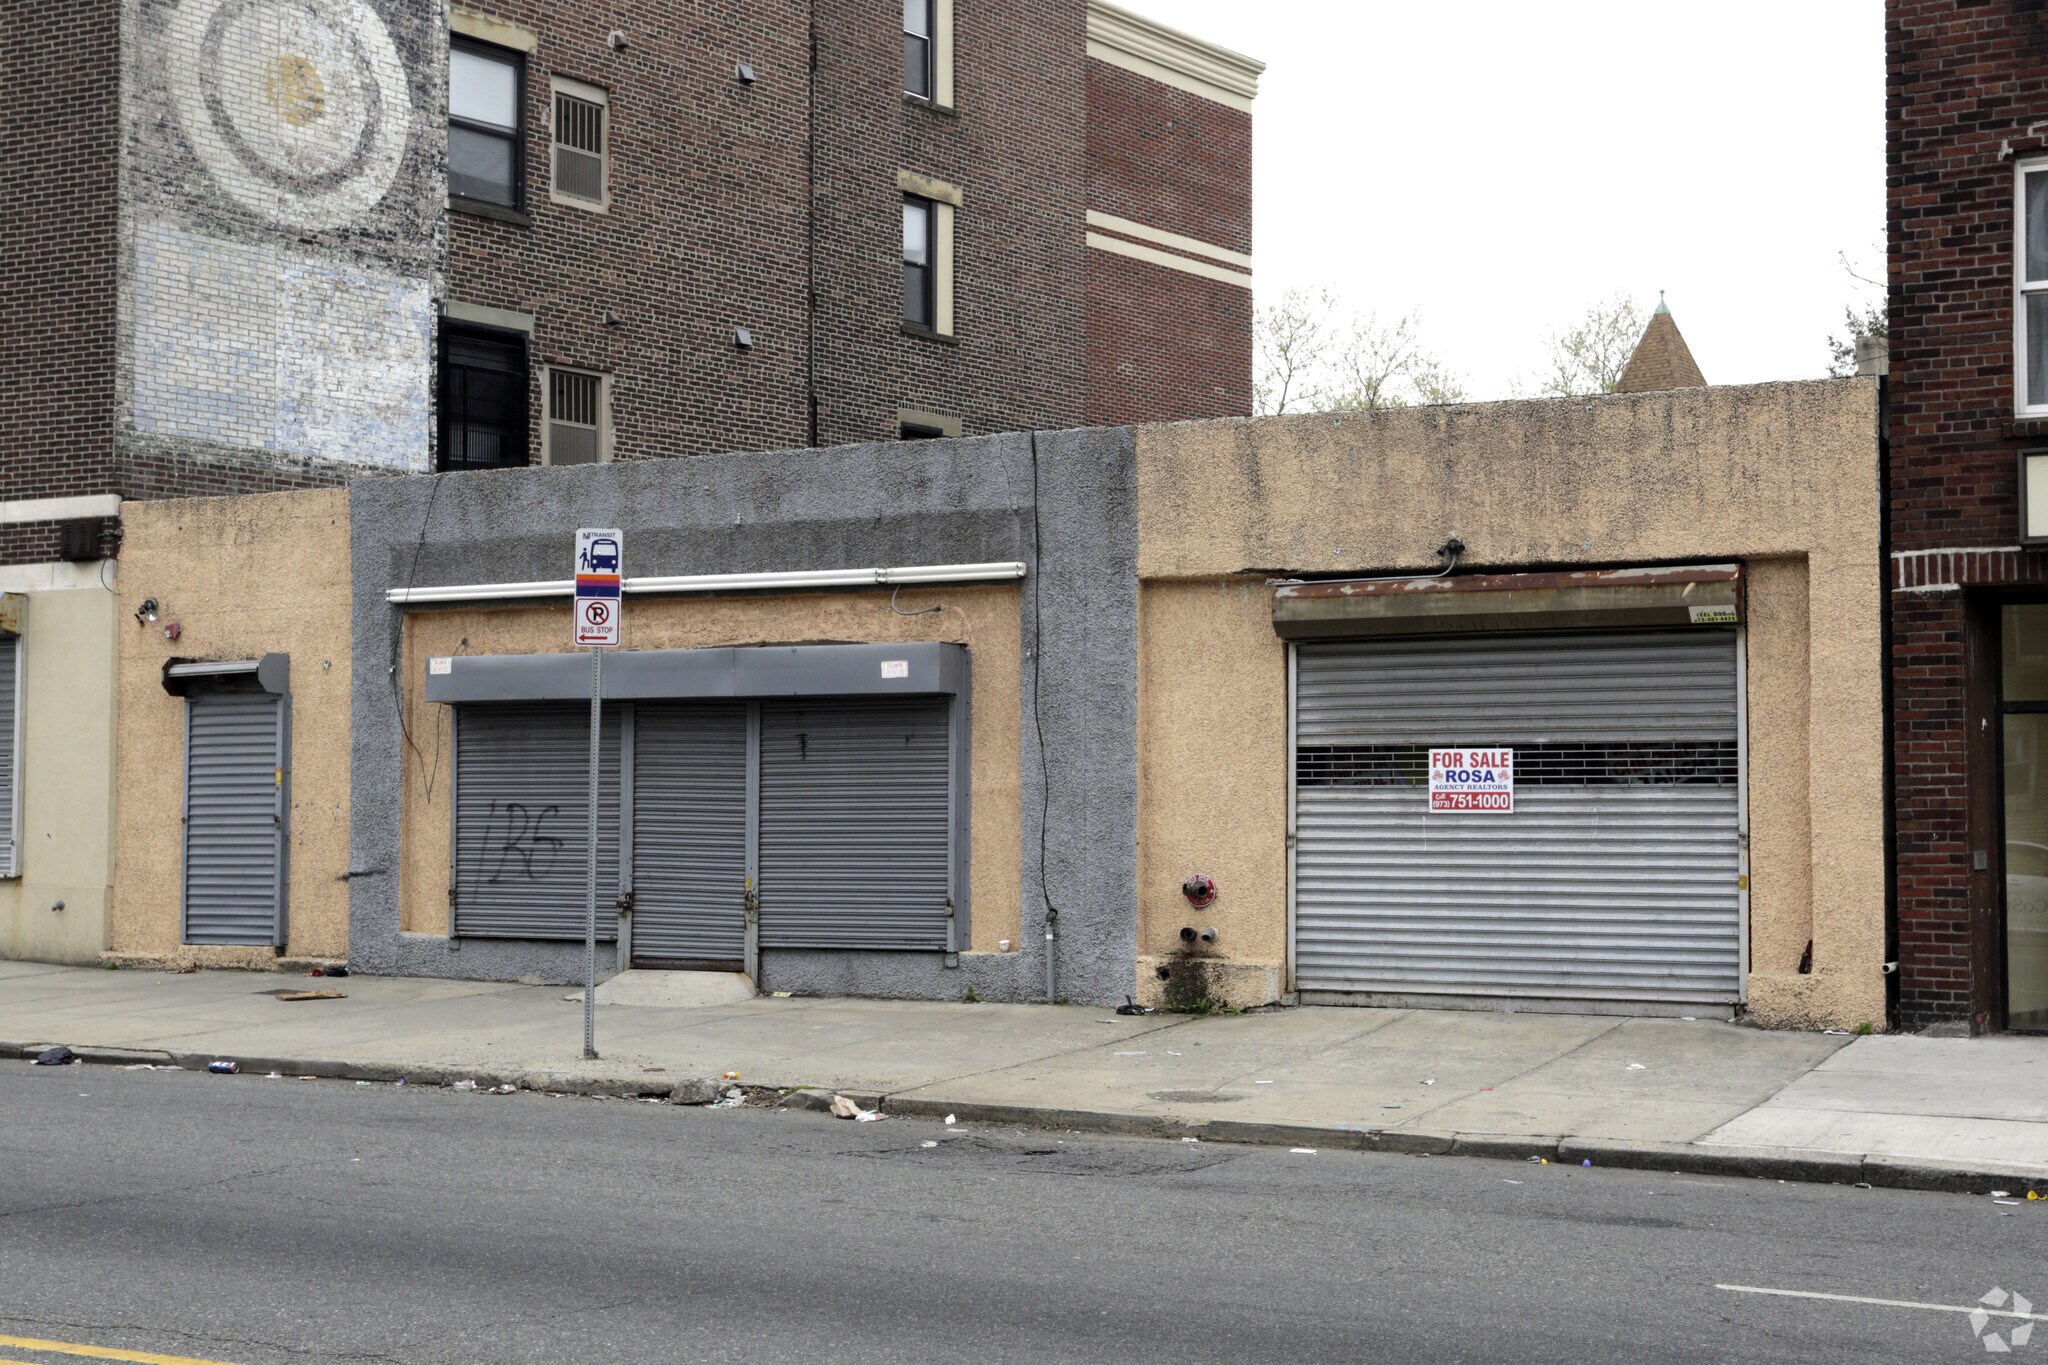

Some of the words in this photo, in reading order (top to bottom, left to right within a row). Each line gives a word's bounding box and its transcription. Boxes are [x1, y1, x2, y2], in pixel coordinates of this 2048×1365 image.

[1433, 752, 1463, 768] FOR
[1470, 752, 1509, 768] SALE
[1446, 770, 1495, 783] ROSA
[1433, 800, 1450, 808] (973)
[1450, 794, 1509, 808] 751-1000
